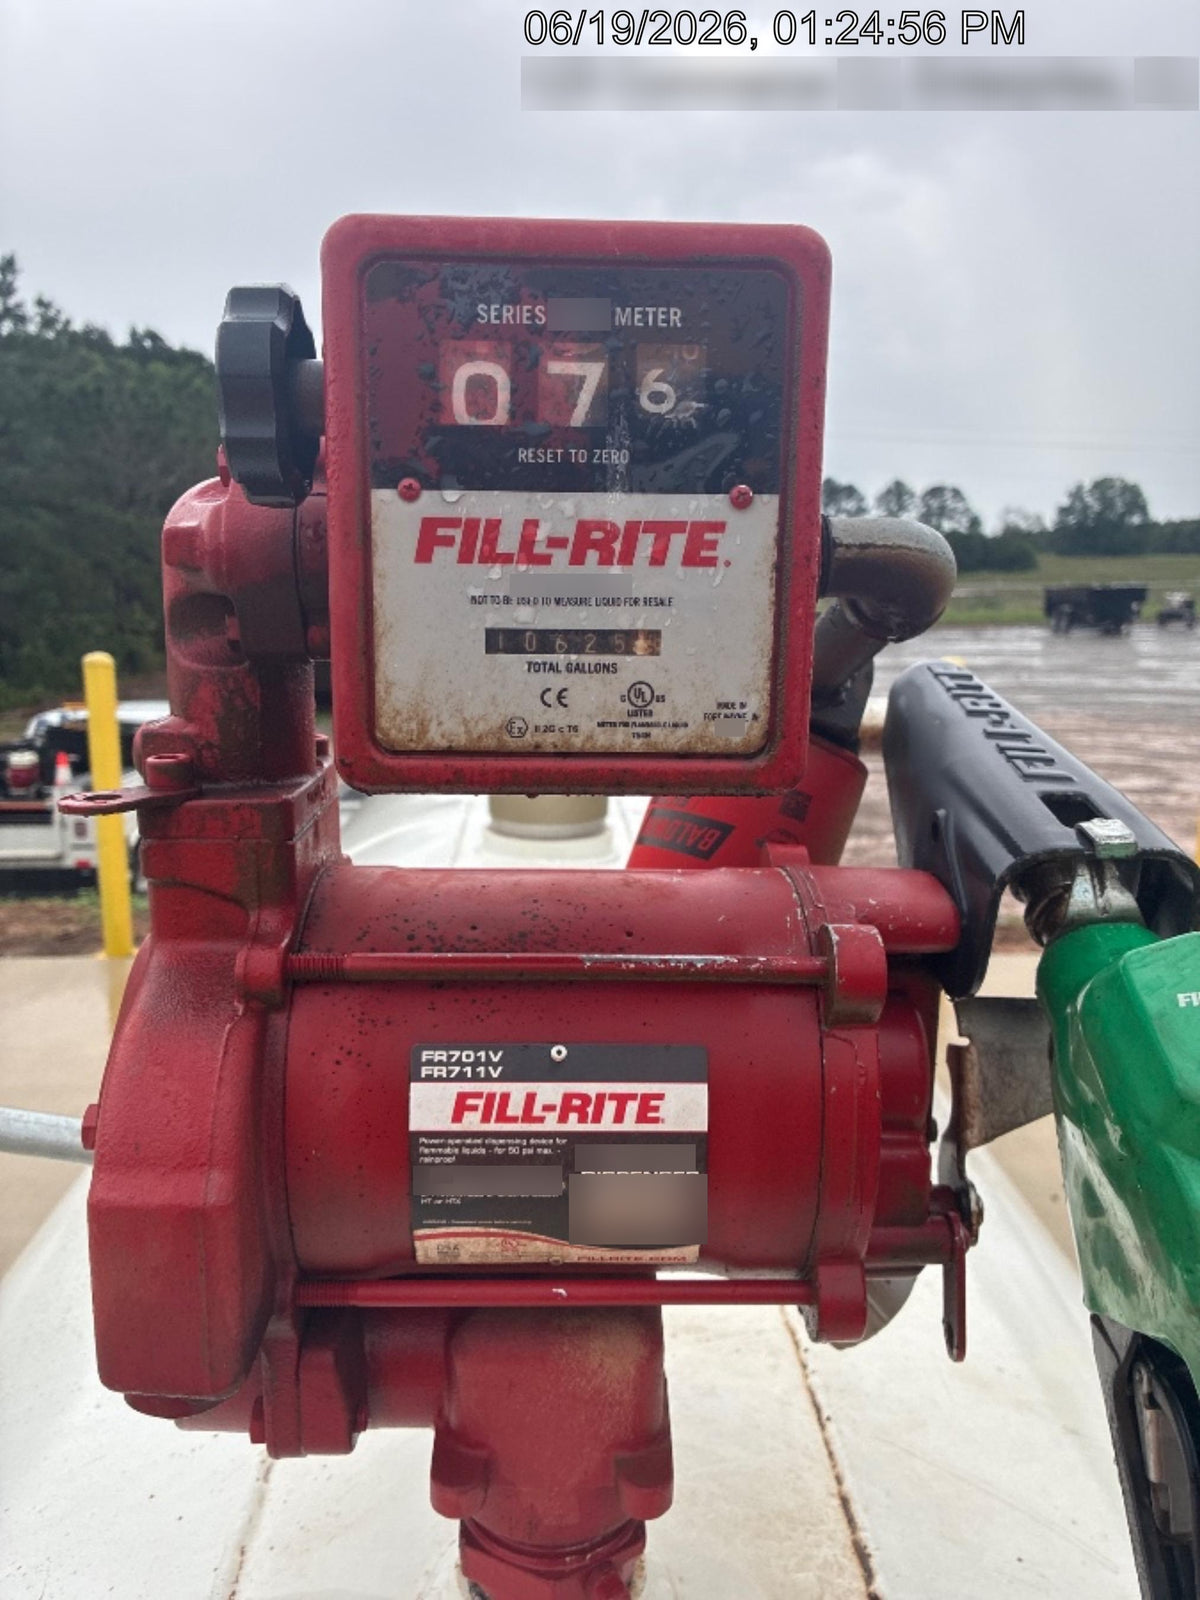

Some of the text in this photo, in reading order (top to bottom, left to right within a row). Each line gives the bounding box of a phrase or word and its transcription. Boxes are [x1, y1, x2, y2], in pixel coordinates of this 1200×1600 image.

[477, 303, 682, 327] SERIES METER
[518, 447, 630, 465] RESET TO ZERO
[414, 517, 727, 567] FILL-RITE
[526, 661, 618, 675] TOTAL GALLONS
[627, 709, 653, 718] LISTED
[421, 1050, 503, 1063] FR701V
[420, 1066, 503, 1078] FR711V
[451, 1091, 665, 1124] FILL-RITE
[556, 1137, 568, 1145] for
[494, 1146, 506, 1155] for
[508, 1146, 520, 1155] 50
